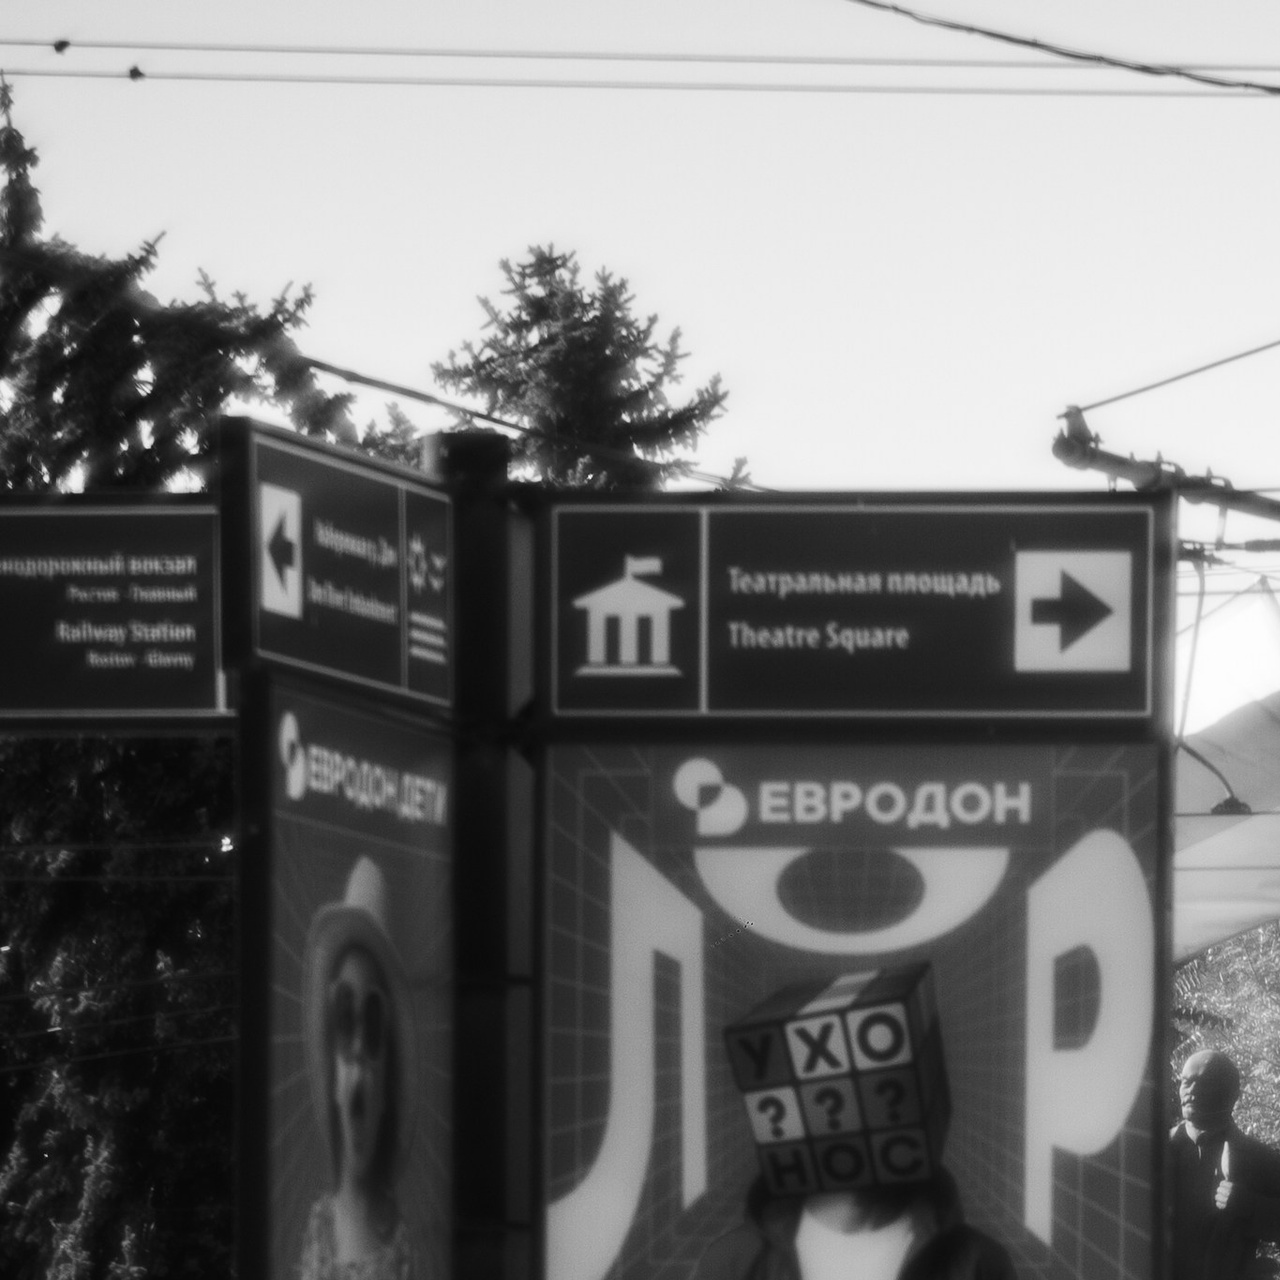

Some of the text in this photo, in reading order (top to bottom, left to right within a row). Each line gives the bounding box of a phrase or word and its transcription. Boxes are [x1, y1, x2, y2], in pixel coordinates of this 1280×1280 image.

[0, 553, 197, 579] нодорожный вокзал
[727, 565, 1001, 600] Театральная площадь
[56, 618, 196, 646] Railway Station
[727, 619, 910, 655] Theatre Square
[758, 781, 1032, 828] ЕВРОДОН
[738, 1010, 906, 1081] УХО
[767, 1134, 925, 1188] НОС
